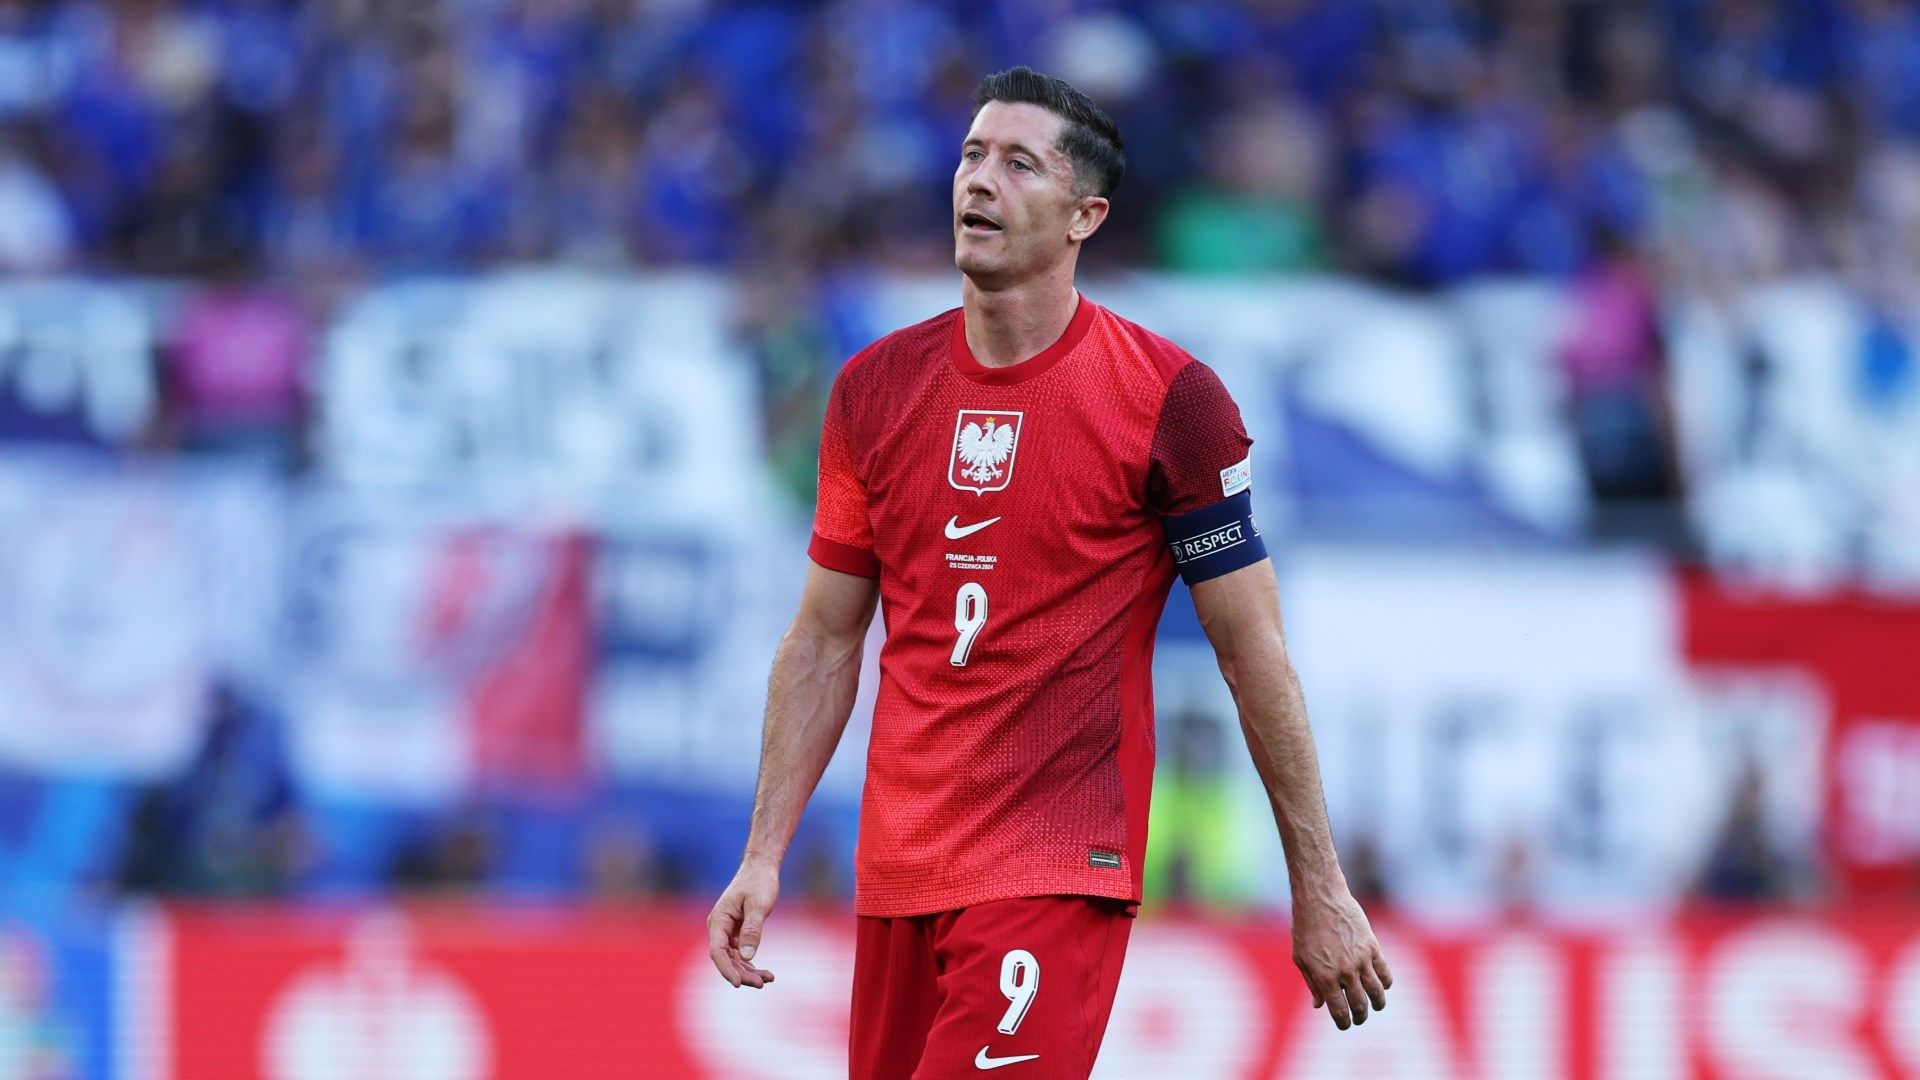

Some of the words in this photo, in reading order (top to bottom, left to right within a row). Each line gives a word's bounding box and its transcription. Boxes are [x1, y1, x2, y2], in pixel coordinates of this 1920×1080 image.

[1184, 525, 1243, 556] RESPECT
[949, 581, 989, 667] 9
[996, 948, 1040, 1036] 9
